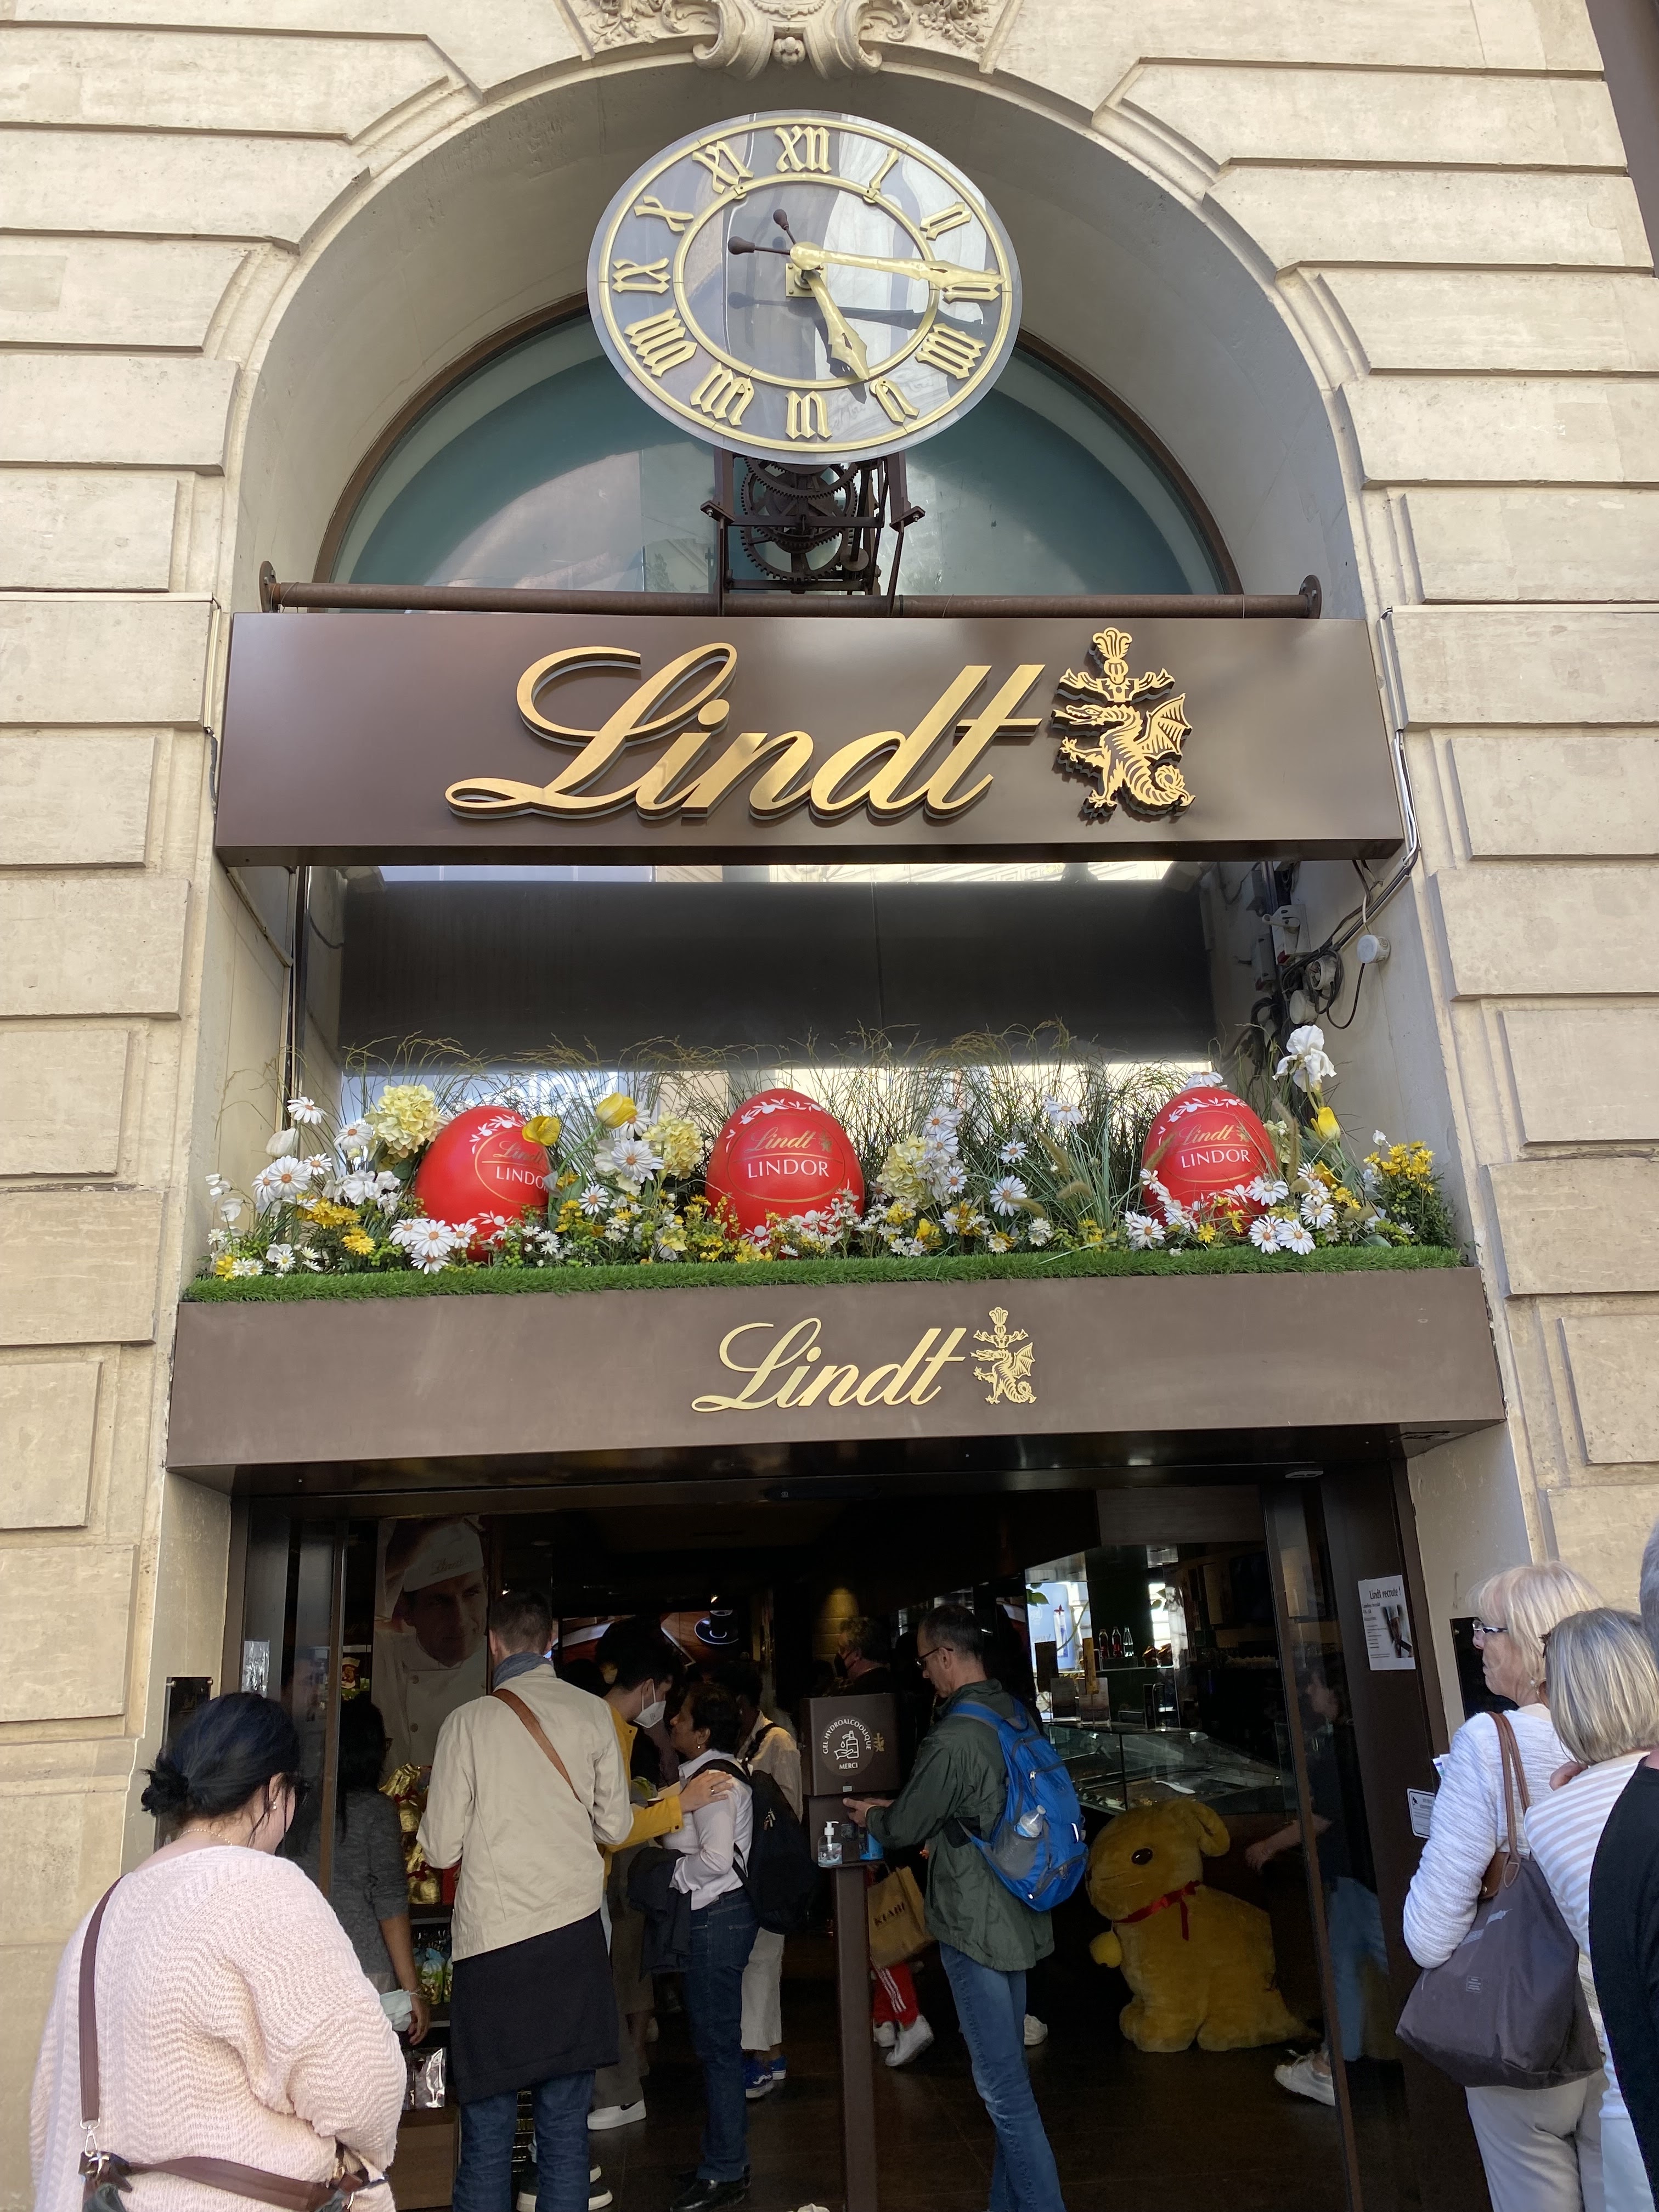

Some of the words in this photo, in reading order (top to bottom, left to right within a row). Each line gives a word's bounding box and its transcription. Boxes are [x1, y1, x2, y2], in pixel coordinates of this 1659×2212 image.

[774, 126, 832, 173] XII
[692, 140, 754, 194] XI
[633, 195, 695, 233] X
[612, 257, 671, 294] IX
[445, 642, 1046, 823] Lindt
[743, 1126, 816, 1153] Lindt
[1178, 1124, 1235, 1147] Lindt
[748, 1159, 830, 1178] LINDOR
[1181, 1149, 1251, 1169] LINDOR
[691, 1317, 967, 1412] Lindt
[1369, 1588, 1381, 1600] Lindt
[1383, 1588, 1398, 1599] recrute
[824, 1718, 872, 1750] HYDROALCOOLIQUE
